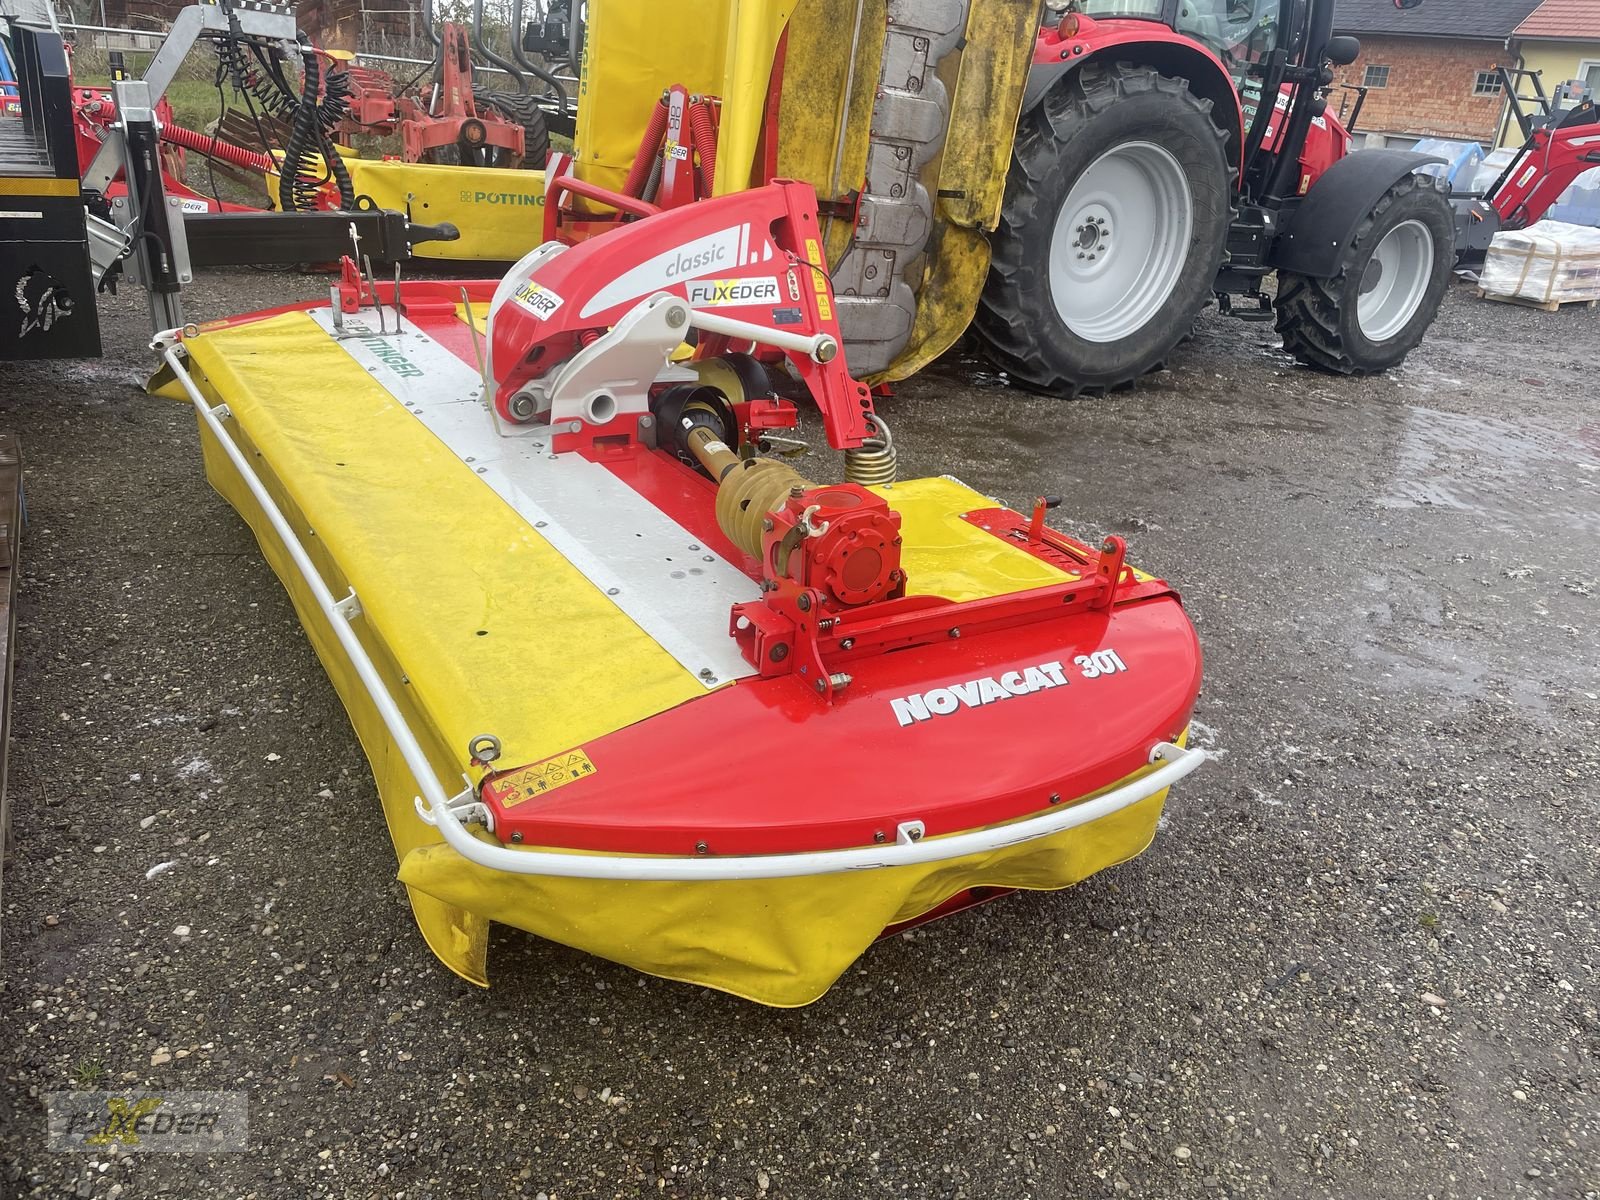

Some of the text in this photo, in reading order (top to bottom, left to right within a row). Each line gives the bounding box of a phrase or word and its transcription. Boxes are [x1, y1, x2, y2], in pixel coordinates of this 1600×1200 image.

[665, 243, 726, 278] classic
[691, 284, 776, 302] FLIXEDER
[890, 648, 1128, 727] NOVACAT 301
